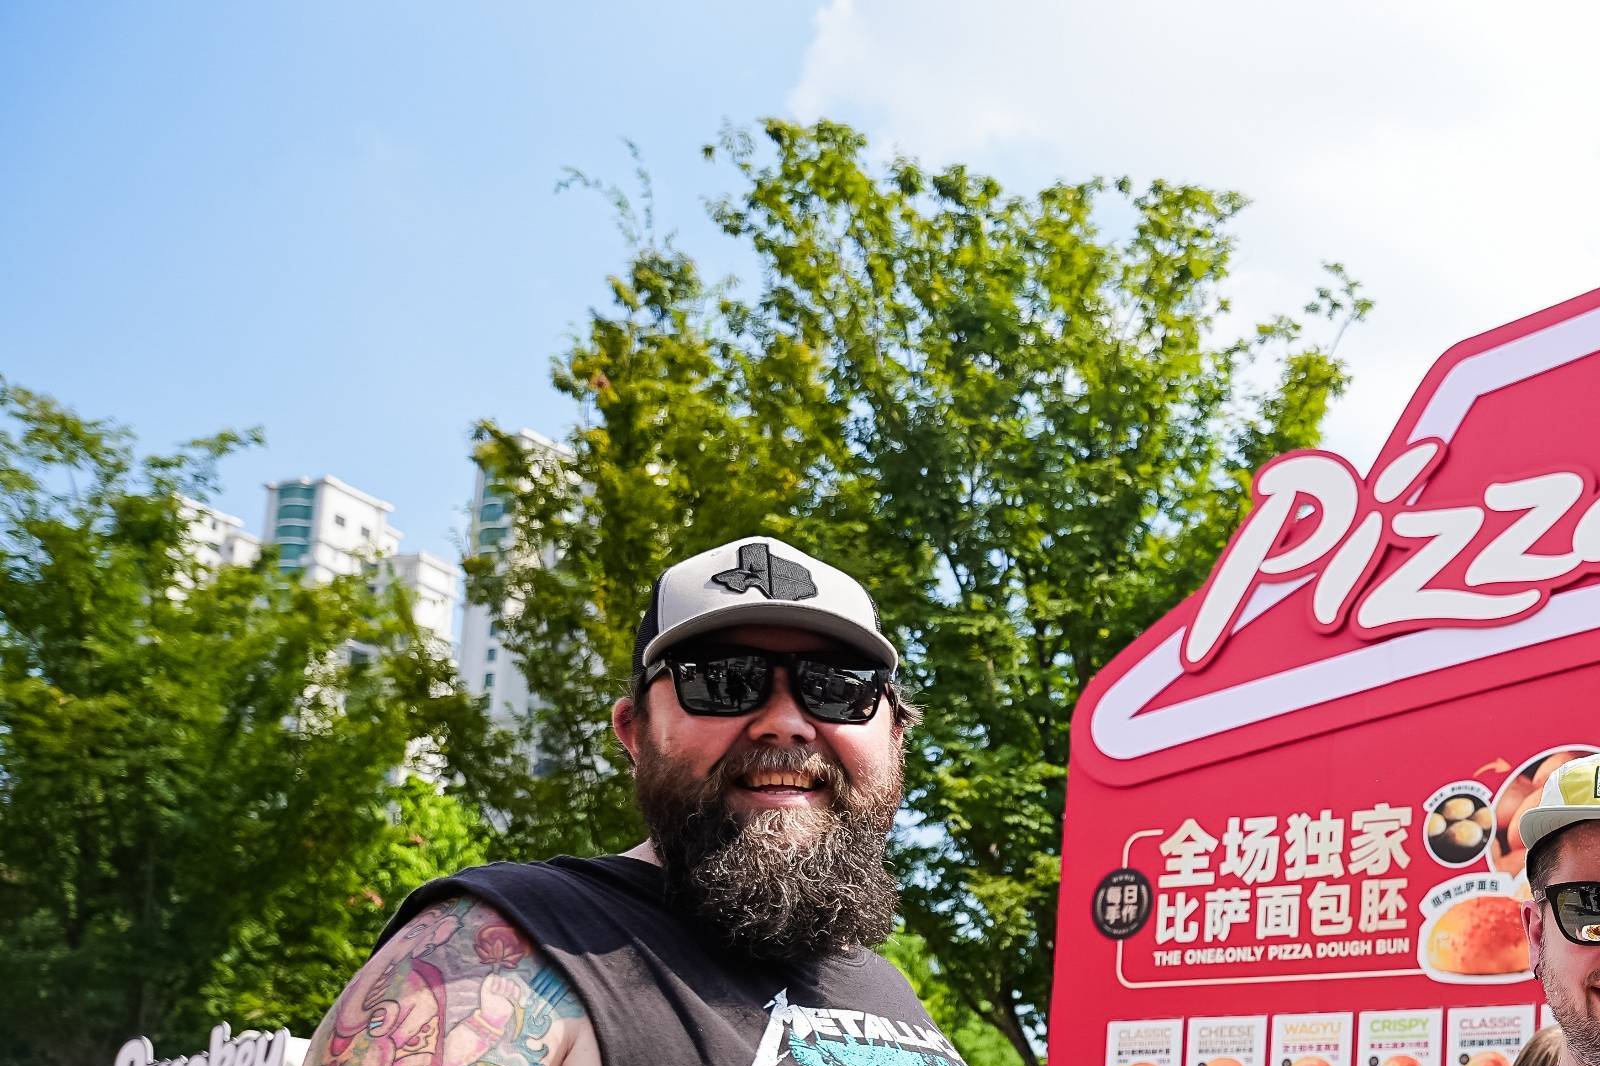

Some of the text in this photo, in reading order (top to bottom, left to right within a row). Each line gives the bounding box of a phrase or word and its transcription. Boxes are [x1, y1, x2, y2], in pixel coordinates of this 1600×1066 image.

[1158, 803, 1413, 888] 全场独家
[1155, 878, 1409, 945] 比萨面包胚
[1153, 938, 1410, 967] THE ONE&ONLY PIZZA DOUGH BUN
[1283, 1021, 1342, 1035] WAGYU
[1369, 1018, 1430, 1033] CRISPY
[1459, 1015, 1521, 1030] CLASSIC
[1118, 1027, 1173, 1041] CLASSIC
[1199, 1024, 1255, 1039] CHEESE
